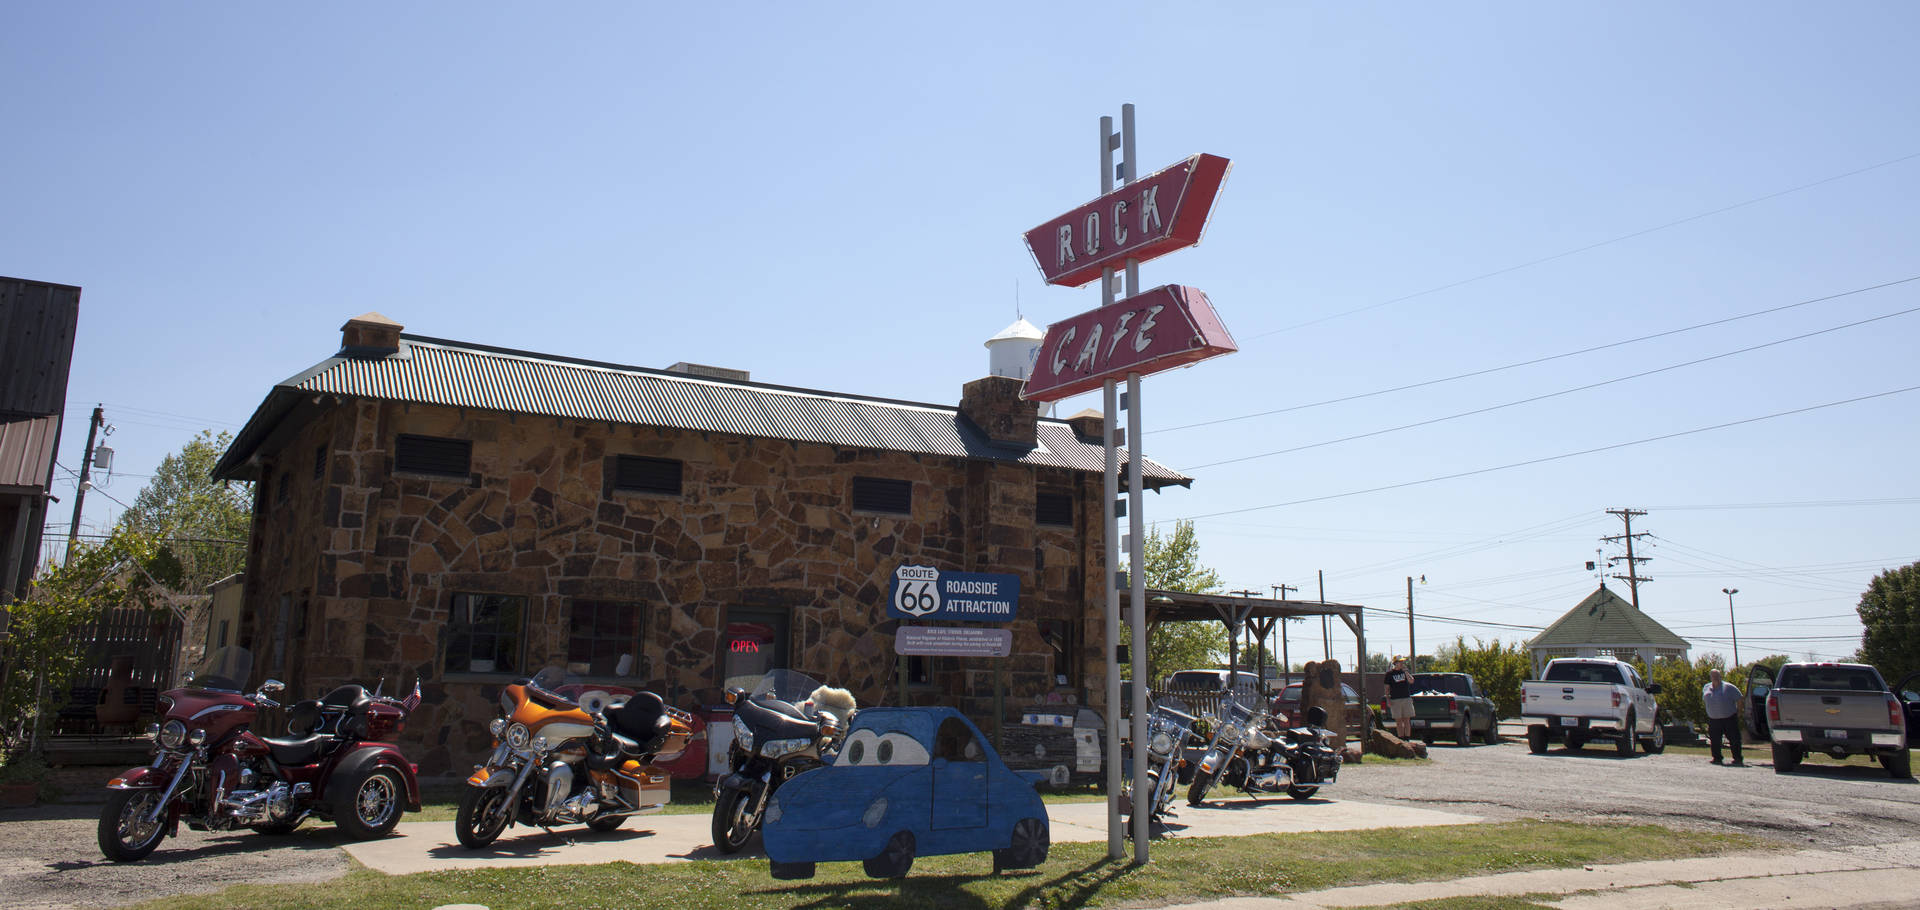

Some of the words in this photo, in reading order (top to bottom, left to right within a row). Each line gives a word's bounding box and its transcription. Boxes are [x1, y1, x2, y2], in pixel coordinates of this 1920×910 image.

[1059, 184, 1162, 267] ROCK
[1053, 304, 1165, 376] CAFE
[901, 568, 935, 579] ROUTE
[946, 580, 998, 595] ROADSIDE
[901, 581, 935, 612] 66
[946, 599, 1010, 614] ATTRACTION
[730, 640, 759, 653] OPEN
